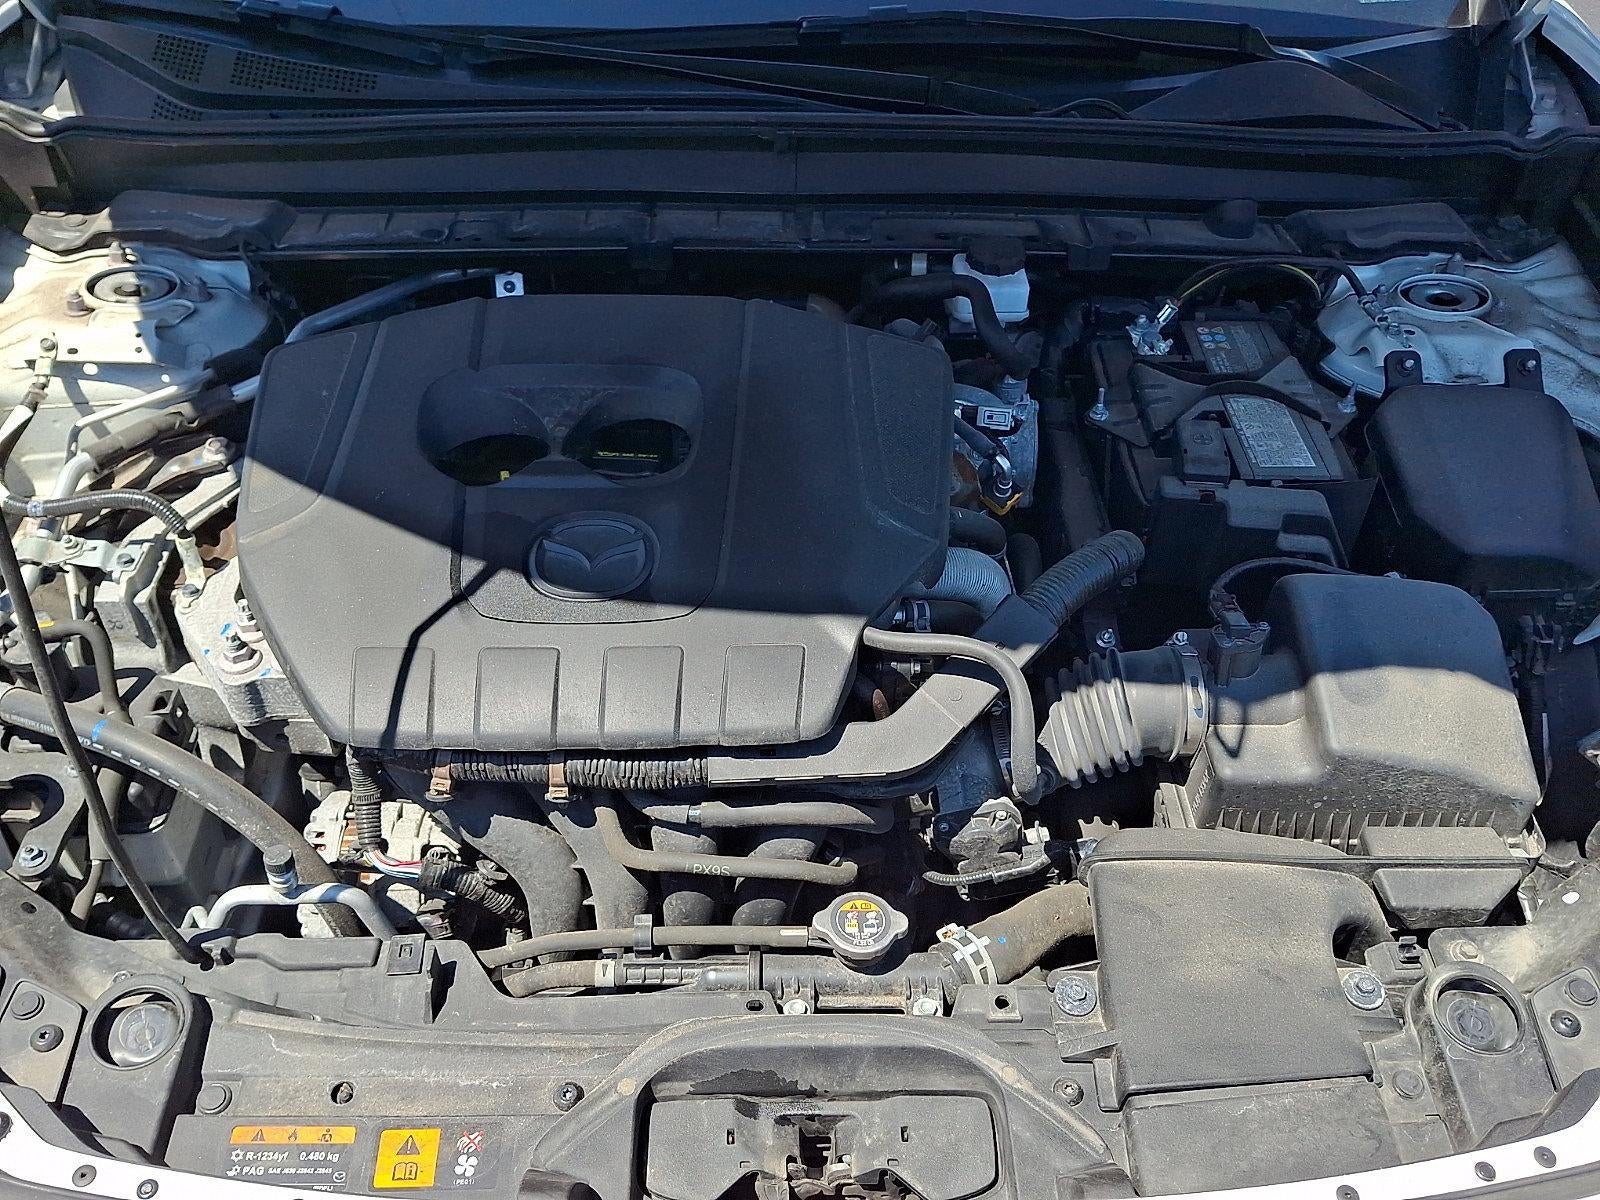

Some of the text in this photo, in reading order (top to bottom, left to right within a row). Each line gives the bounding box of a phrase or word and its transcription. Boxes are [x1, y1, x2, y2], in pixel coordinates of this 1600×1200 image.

[245, 1151, 289, 1163] R-1234yf
[326, 1151, 340, 1163] kg
[242, 1166, 265, 1176] PAG
